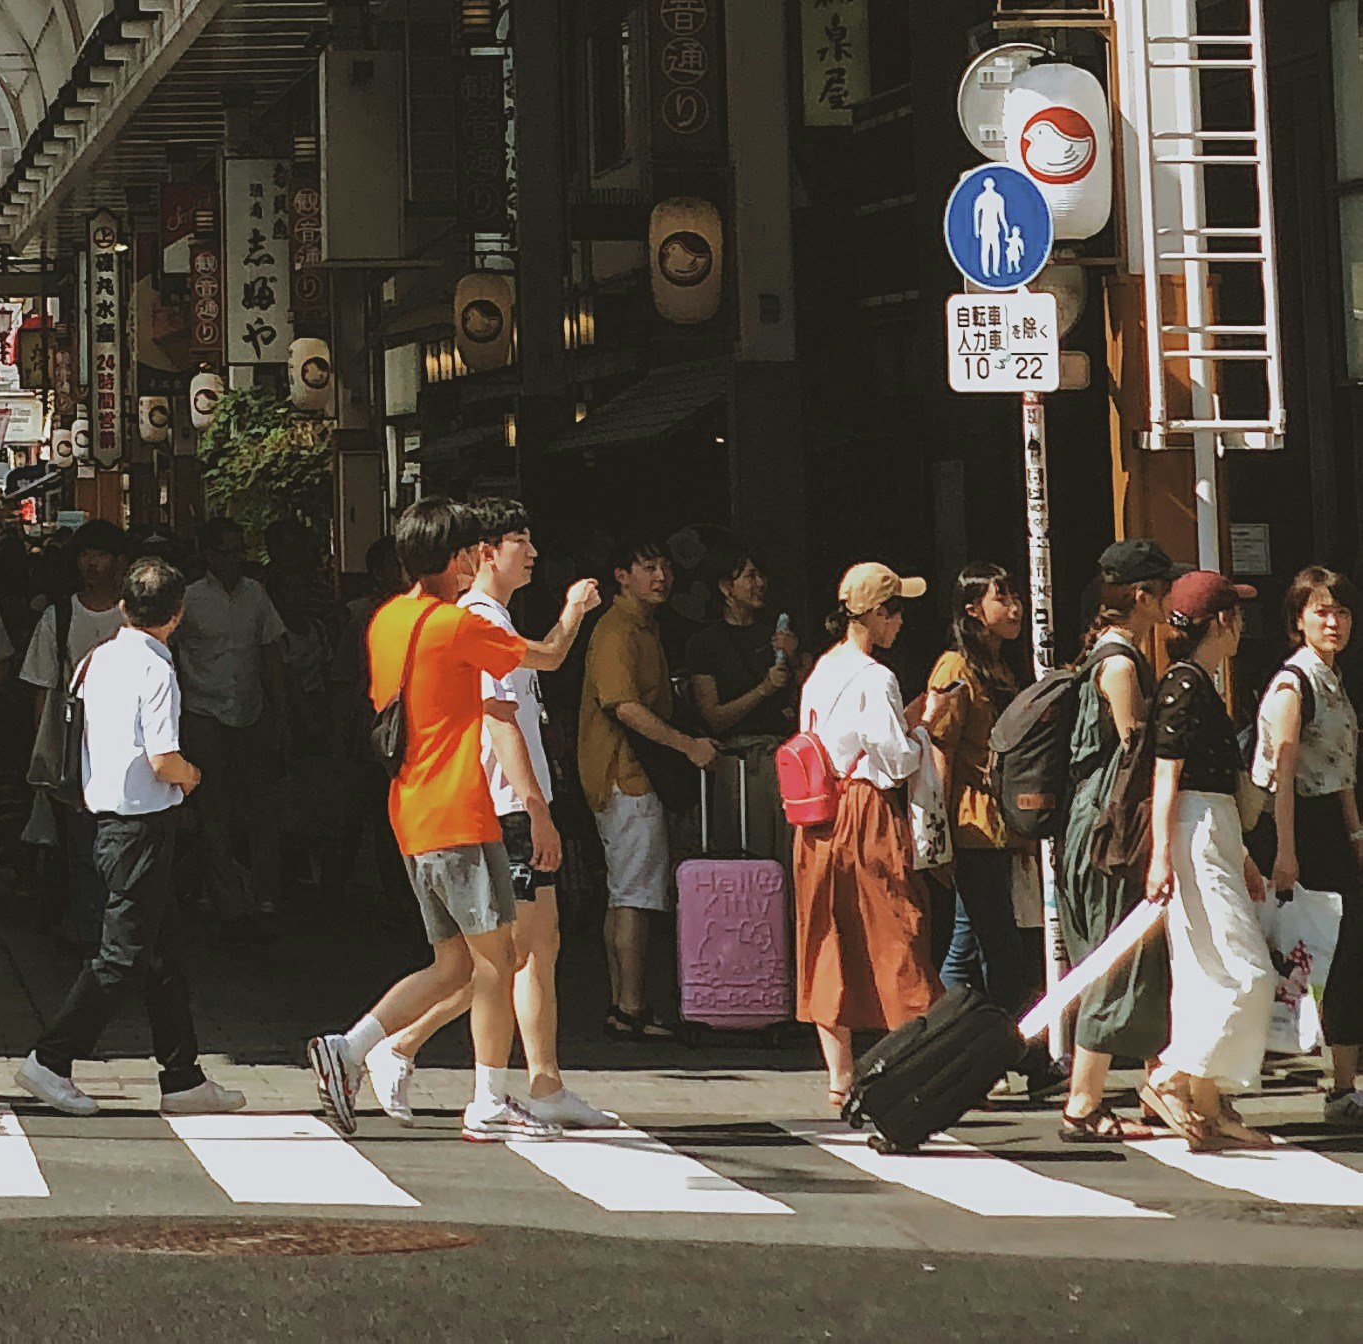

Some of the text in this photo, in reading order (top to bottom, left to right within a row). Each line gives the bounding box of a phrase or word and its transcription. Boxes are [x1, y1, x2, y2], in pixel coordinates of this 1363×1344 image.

[956, 305, 1002, 328] 自転車
[1011, 316, 1049, 340] を除く
[957, 329, 1003, 352] 人力車
[964, 356, 1044, 380] 10 22
